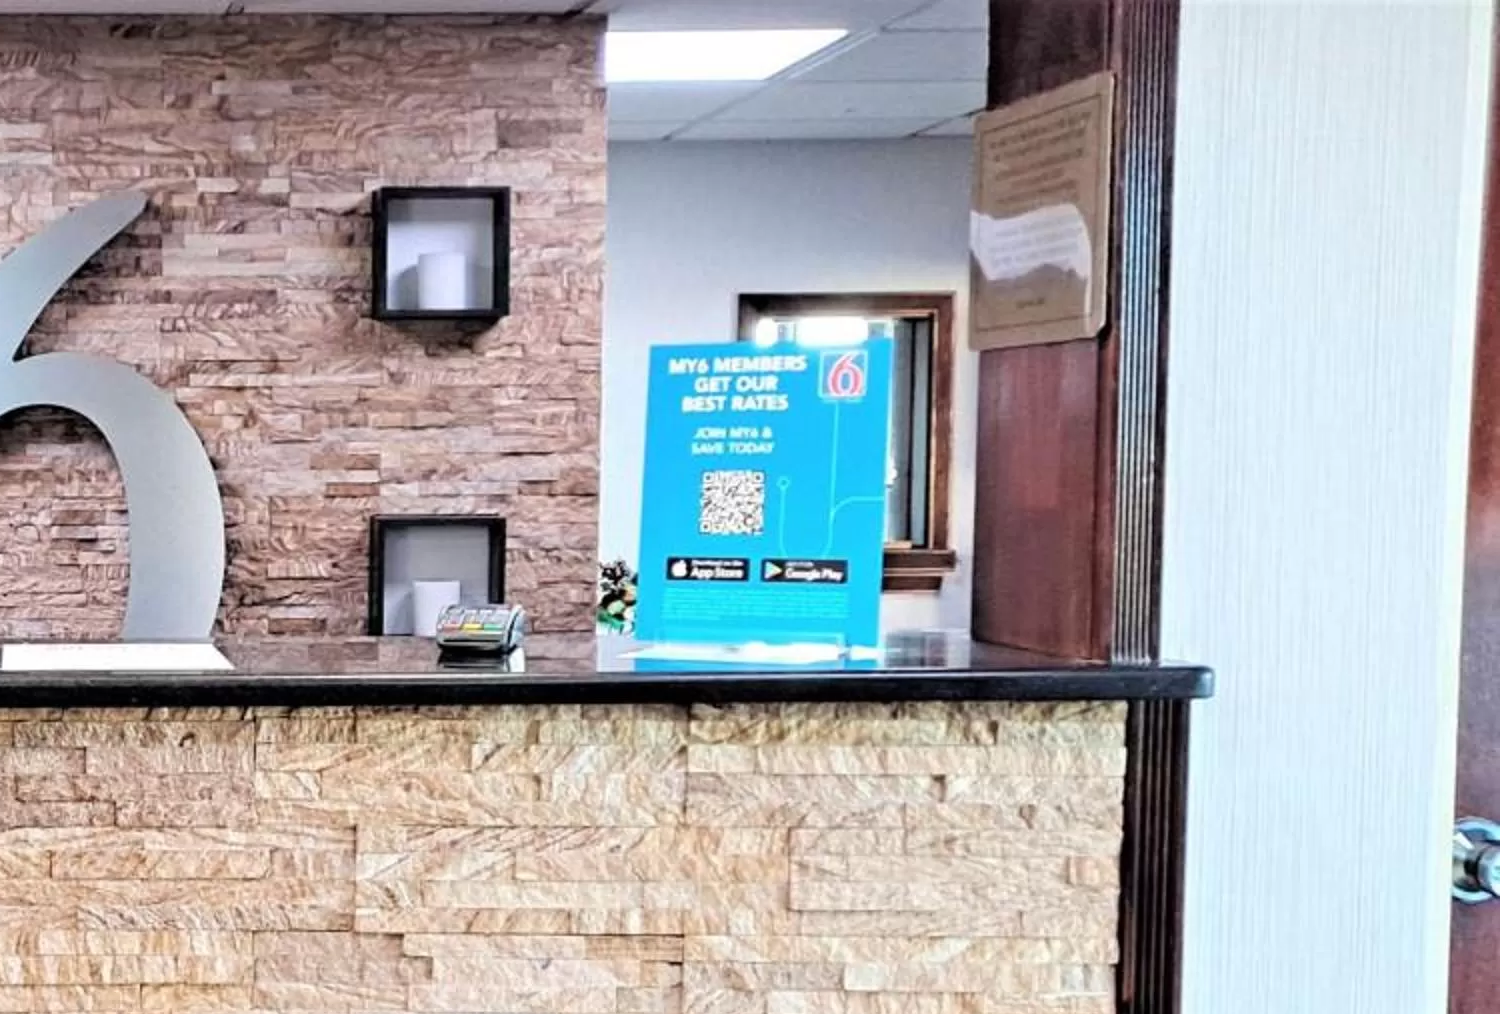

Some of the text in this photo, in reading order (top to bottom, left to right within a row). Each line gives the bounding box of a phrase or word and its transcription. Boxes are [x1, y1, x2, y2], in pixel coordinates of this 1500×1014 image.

[668, 355, 807, 375] MY6 MEMBERS
[829, 351, 864, 396] 6
[694, 375, 778, 393] GET OUR
[681, 394, 789, 413] BEST RATES
[694, 427, 726, 439] JOIN
[691, 441, 775, 455] SAVE TODAY
[690, 567, 744, 580] App Store
[785, 567, 844, 581] Google Play
